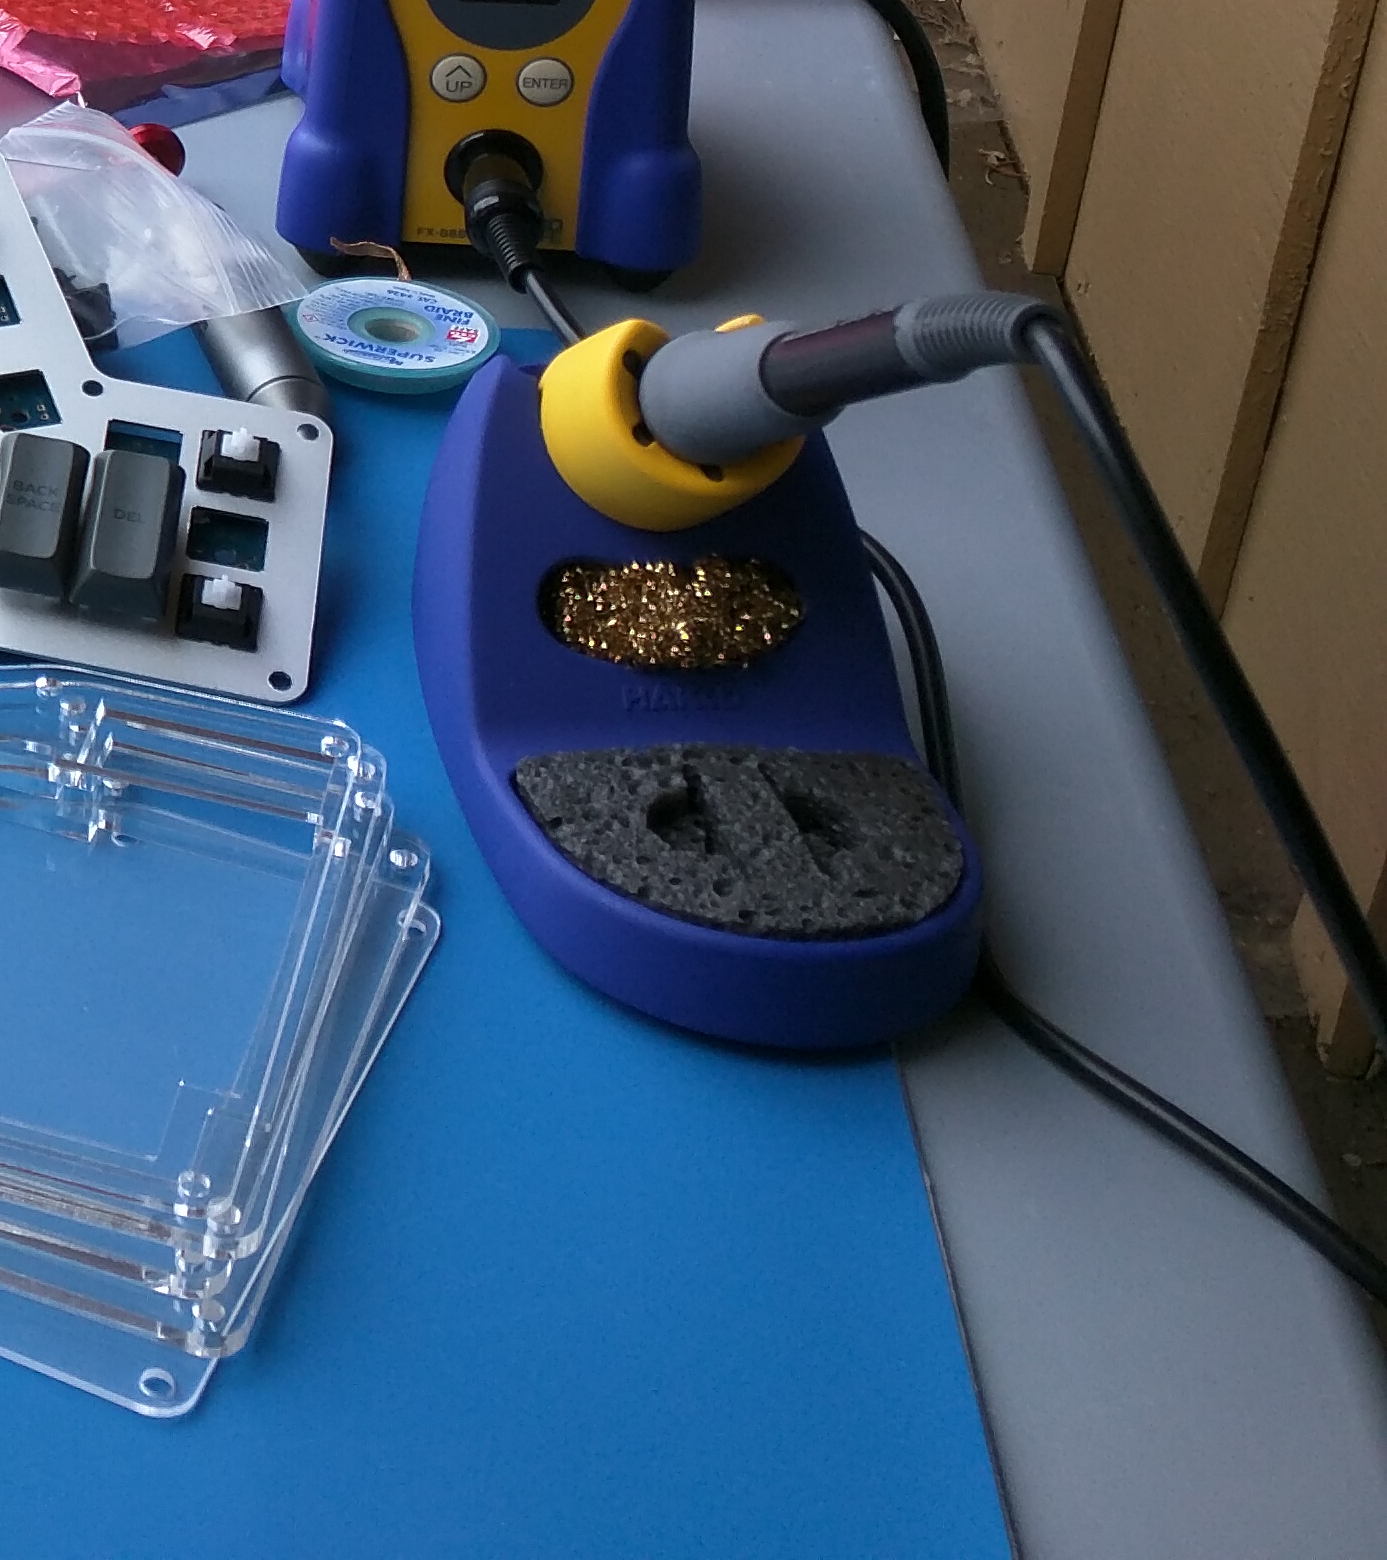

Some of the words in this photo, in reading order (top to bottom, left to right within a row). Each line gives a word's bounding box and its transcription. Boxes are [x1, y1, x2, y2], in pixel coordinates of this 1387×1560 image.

[445, 80, 473, 93] UP
[522, 76, 569, 91] ENTER
[423, 304, 476, 320] BRAID
[435, 313, 472, 326] FINE
[324, 332, 437, 364] SUPERWICK
[13, 479, 59, 497] BACK
[5, 493, 60, 513] SPACE
[113, 508, 147, 524] DEL
